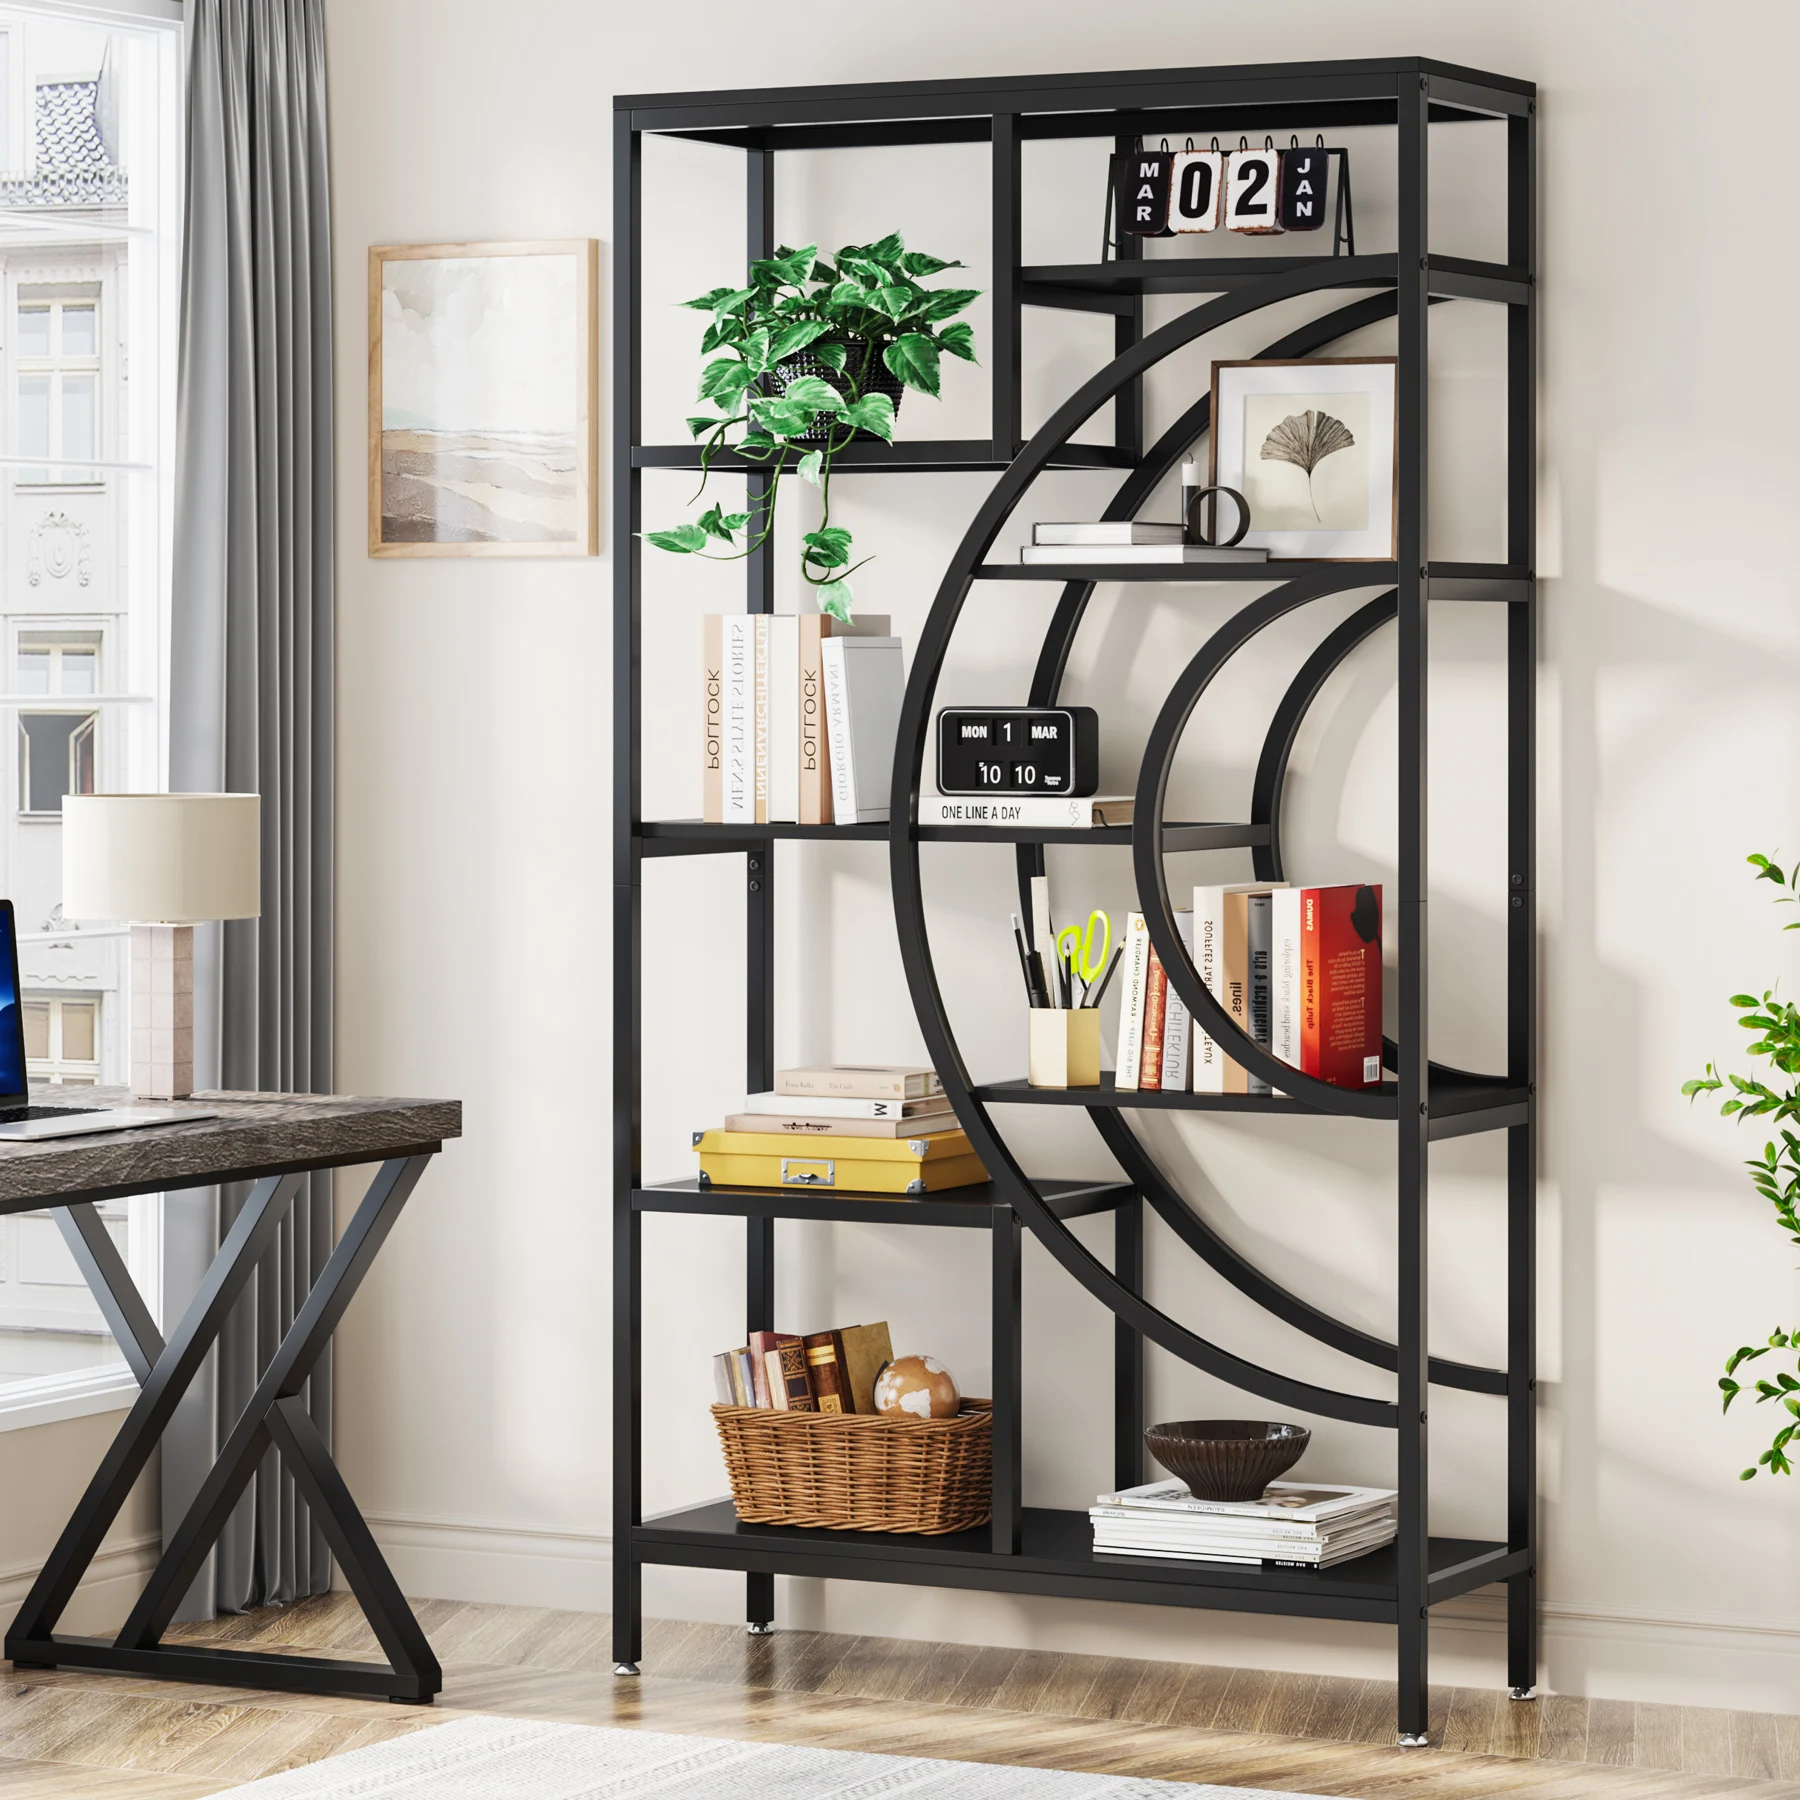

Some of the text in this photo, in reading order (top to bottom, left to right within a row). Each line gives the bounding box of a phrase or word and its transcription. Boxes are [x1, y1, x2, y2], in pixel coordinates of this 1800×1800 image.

[1136, 162, 1159, 222] MAR
[1295, 158, 1313, 217] JAN
[961, 722, 1058, 742] MON 1 MAR
[980, 765, 1001, 784] 10
[1015, 765, 1036, 784] 10
[942, 805, 1021, 820] ONE LINE A DAY
[1187, 1504, 1226, 1512] RAUMIDEEN
